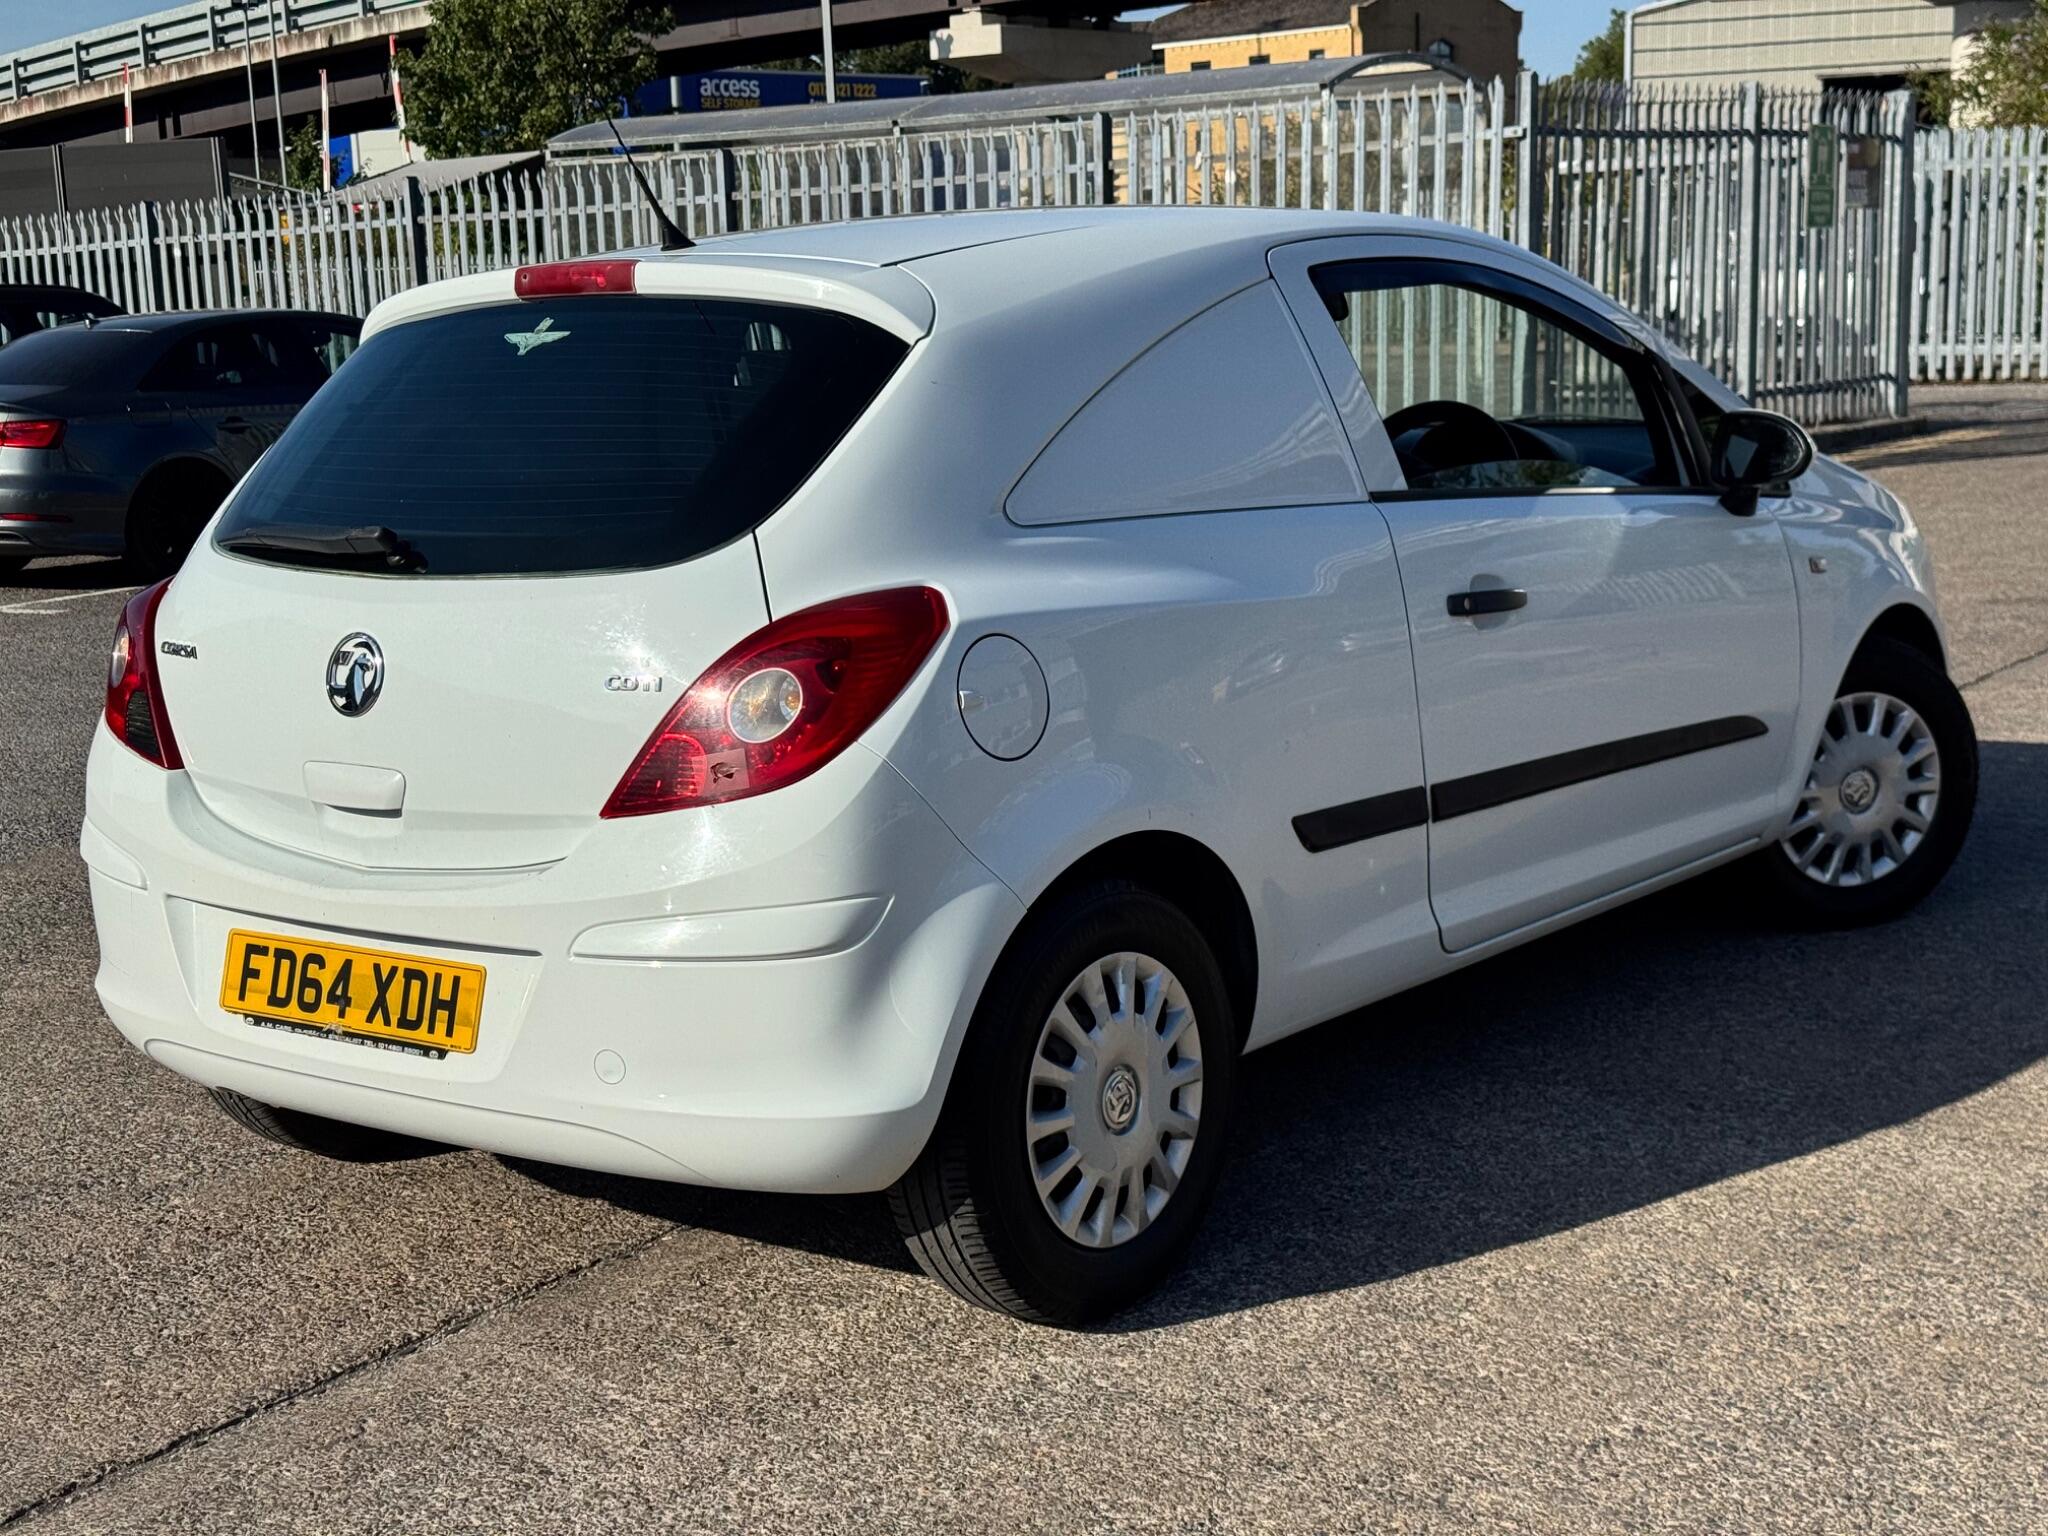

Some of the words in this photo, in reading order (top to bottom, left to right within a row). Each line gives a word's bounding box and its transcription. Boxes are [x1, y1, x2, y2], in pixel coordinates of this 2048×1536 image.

[700, 78, 761, 98] access
[701, 97, 722, 109] SELF
[160, 641, 198, 660] CORSA
[238, 943, 354, 1019] FD64
[365, 962, 461, 1038] XDH
